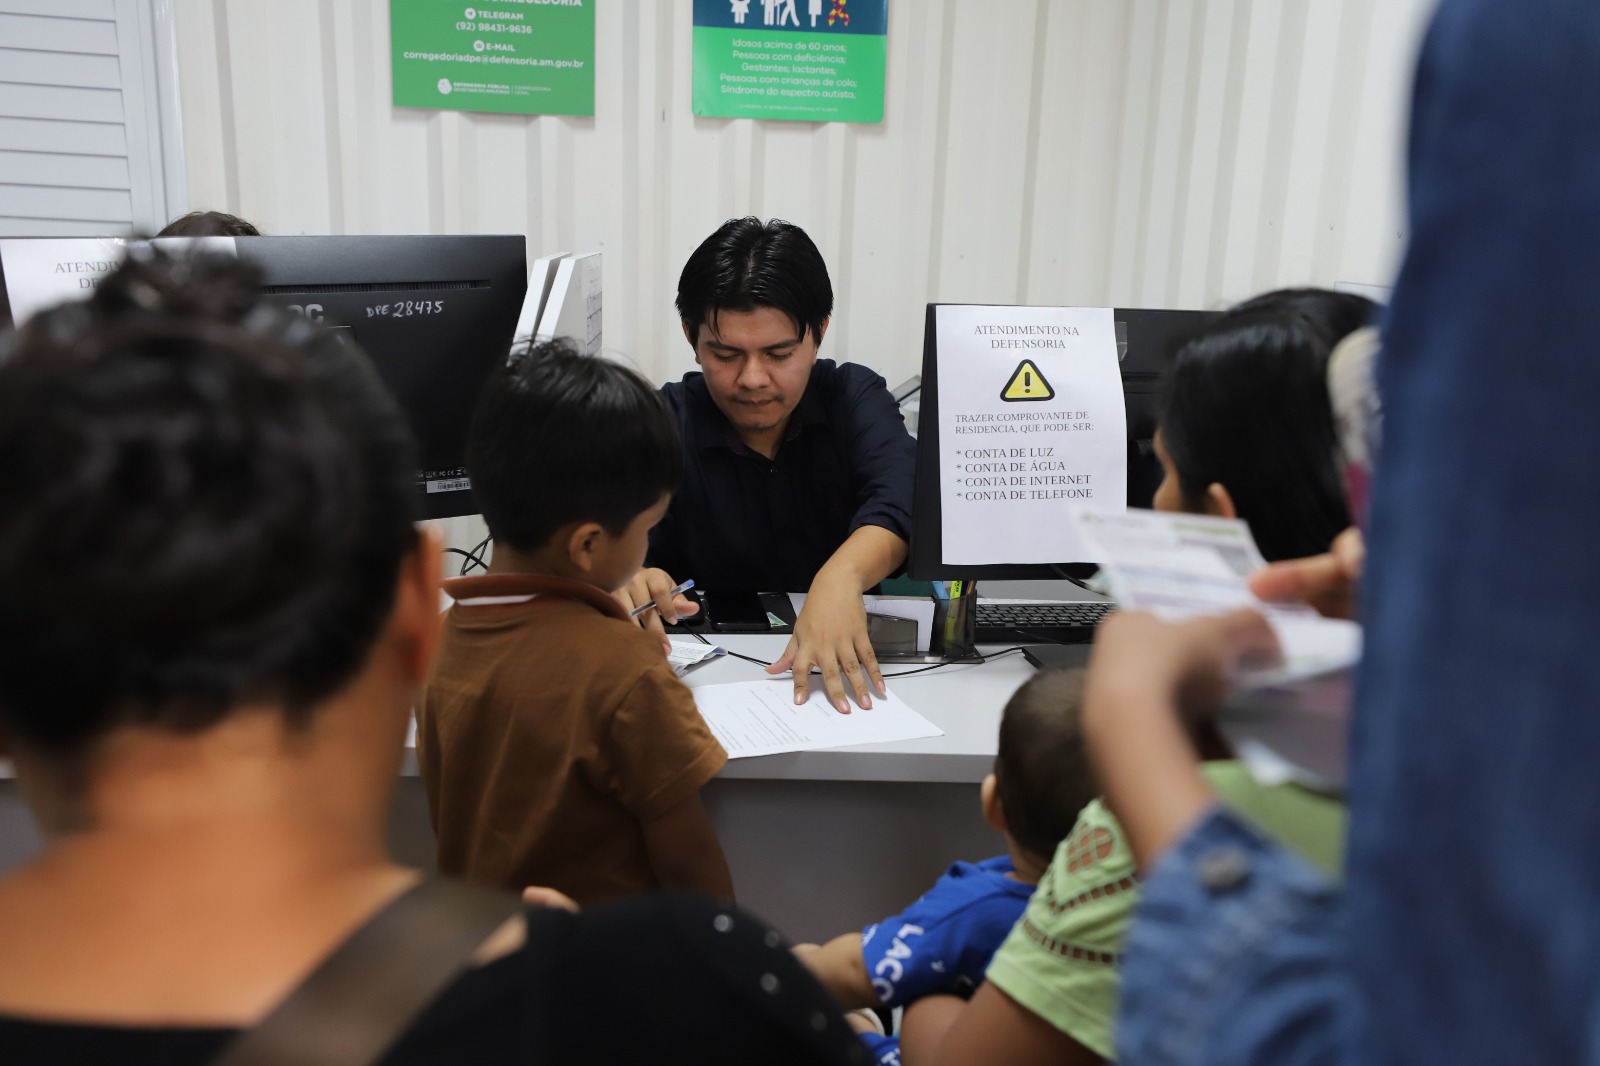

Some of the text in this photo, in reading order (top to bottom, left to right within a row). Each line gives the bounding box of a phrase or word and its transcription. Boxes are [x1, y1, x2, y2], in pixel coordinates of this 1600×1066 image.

[478, 10, 524, 20] TELEGRAM
[456, 21, 532, 34] (92) 98431-9636
[486, 43, 515, 51] E-MAIL
[732, 39, 762, 48] Idosos
[764, 41, 793, 50] acima
[795, 41, 807, 50] de
[808, 42, 821, 51] 60
[732, 50, 770, 60] Pessoas
[772, 53, 793, 61] com
[720, 73, 757, 83] Pessoas
[759, 76, 780, 84] com
[822, 78, 835, 86] de
[766, 87, 779, 95] do
[780, 89, 820, 99] espectro
[366, 300, 444, 318] DPE 28475
[974, 325, 1080, 336] ATENDIMENTO NA
[991, 339, 1066, 349] DEFENSORIA
[955, 411, 1090, 423] TRAZER COMPROVANTE DE
[955, 422, 1095, 434] RESIDENCIA, QUE PODE SER:
[965, 447, 1054, 459] CONTA DE LUZ
[965, 459, 1066, 473] CONTA DE ÁGUA
[965, 474, 1092, 487] CONTA DE INTERNET
[965, 488, 1093, 501] CONTA DE TELEFONE
